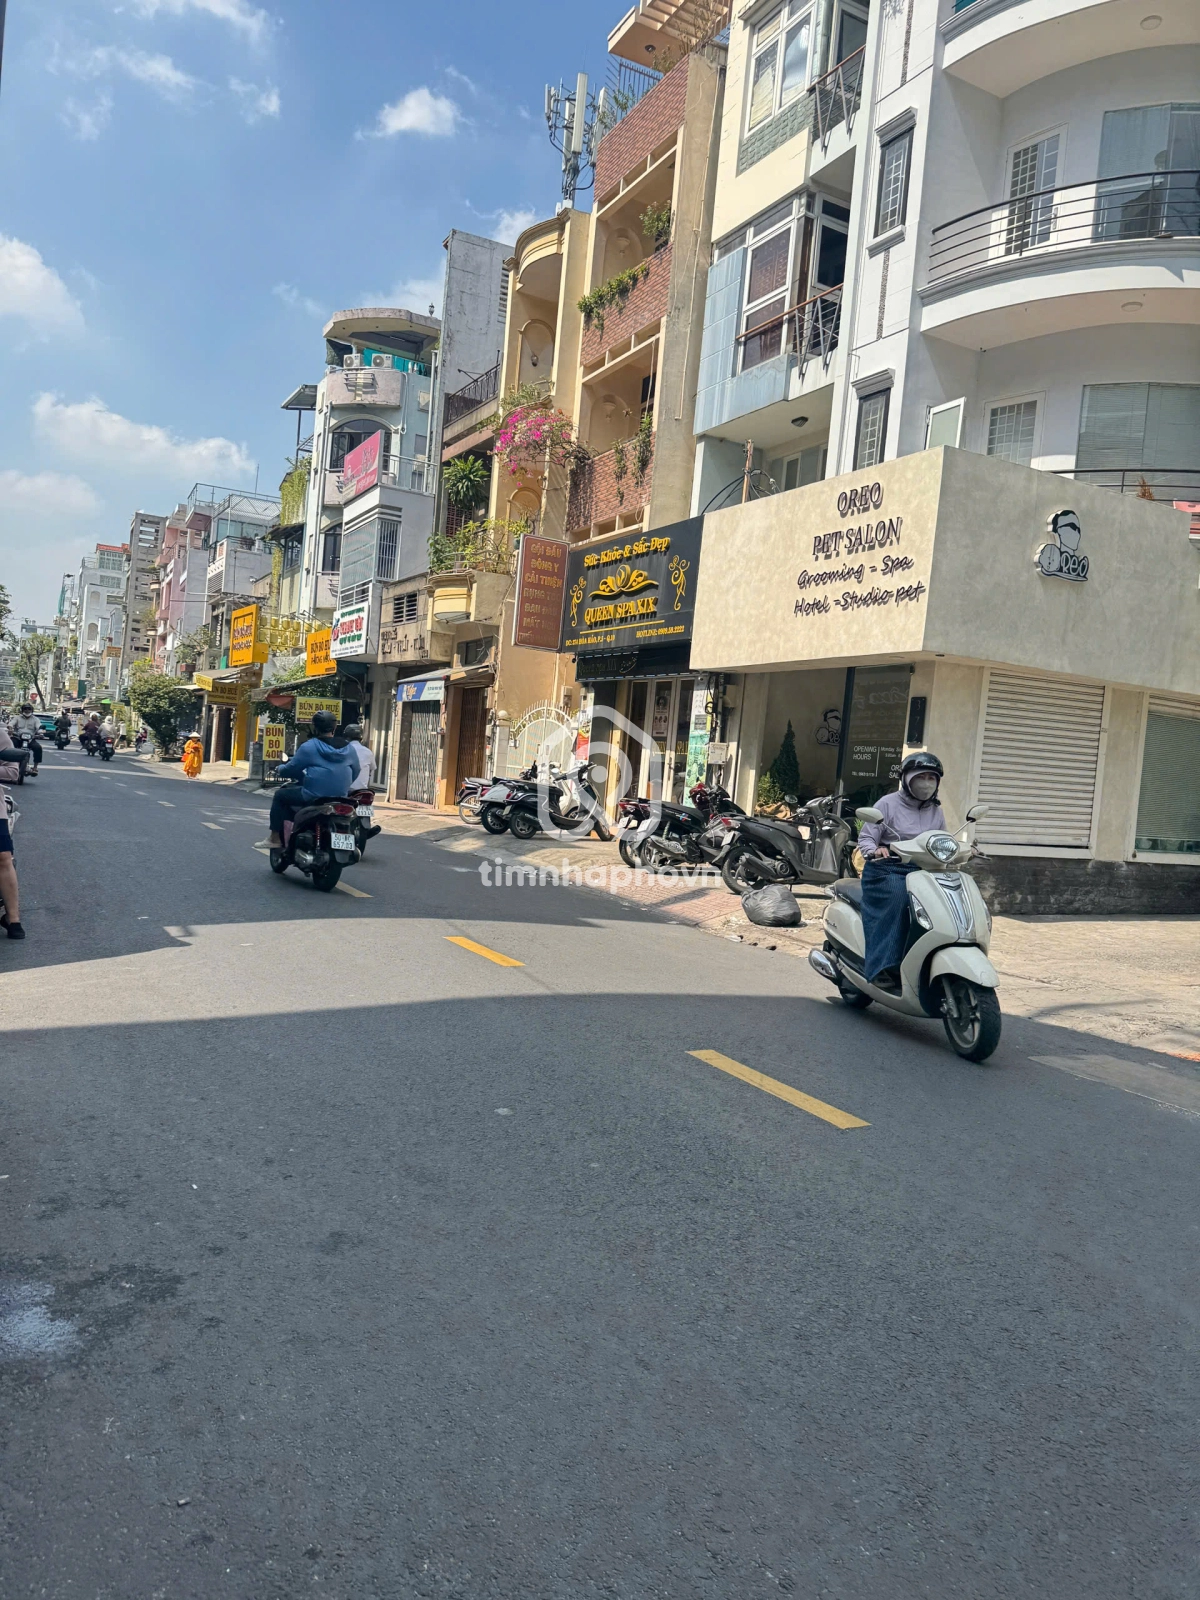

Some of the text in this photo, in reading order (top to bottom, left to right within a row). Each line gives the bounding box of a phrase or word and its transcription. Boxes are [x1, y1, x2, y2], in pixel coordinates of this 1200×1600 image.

[837, 482, 883, 513] OREO
[812, 516, 902, 556] PET SALON
[624, 545, 631, 557] &
[797, 562, 865, 586] Grooming
[881, 555, 914, 576] Spa
[794, 595, 831, 615] Hotel
[840, 586, 893, 610] Studio
[895, 580, 926, 606] pet
[584, 596, 658, 625] QUEEN SPA XIX
[299, 700, 313, 711] BÚN
[325, 701, 340, 712] HUẾ
[265, 725, 284, 737] BÚN
[268, 737, 280, 749] BÒ
[853, 745, 877, 753] OPENING
